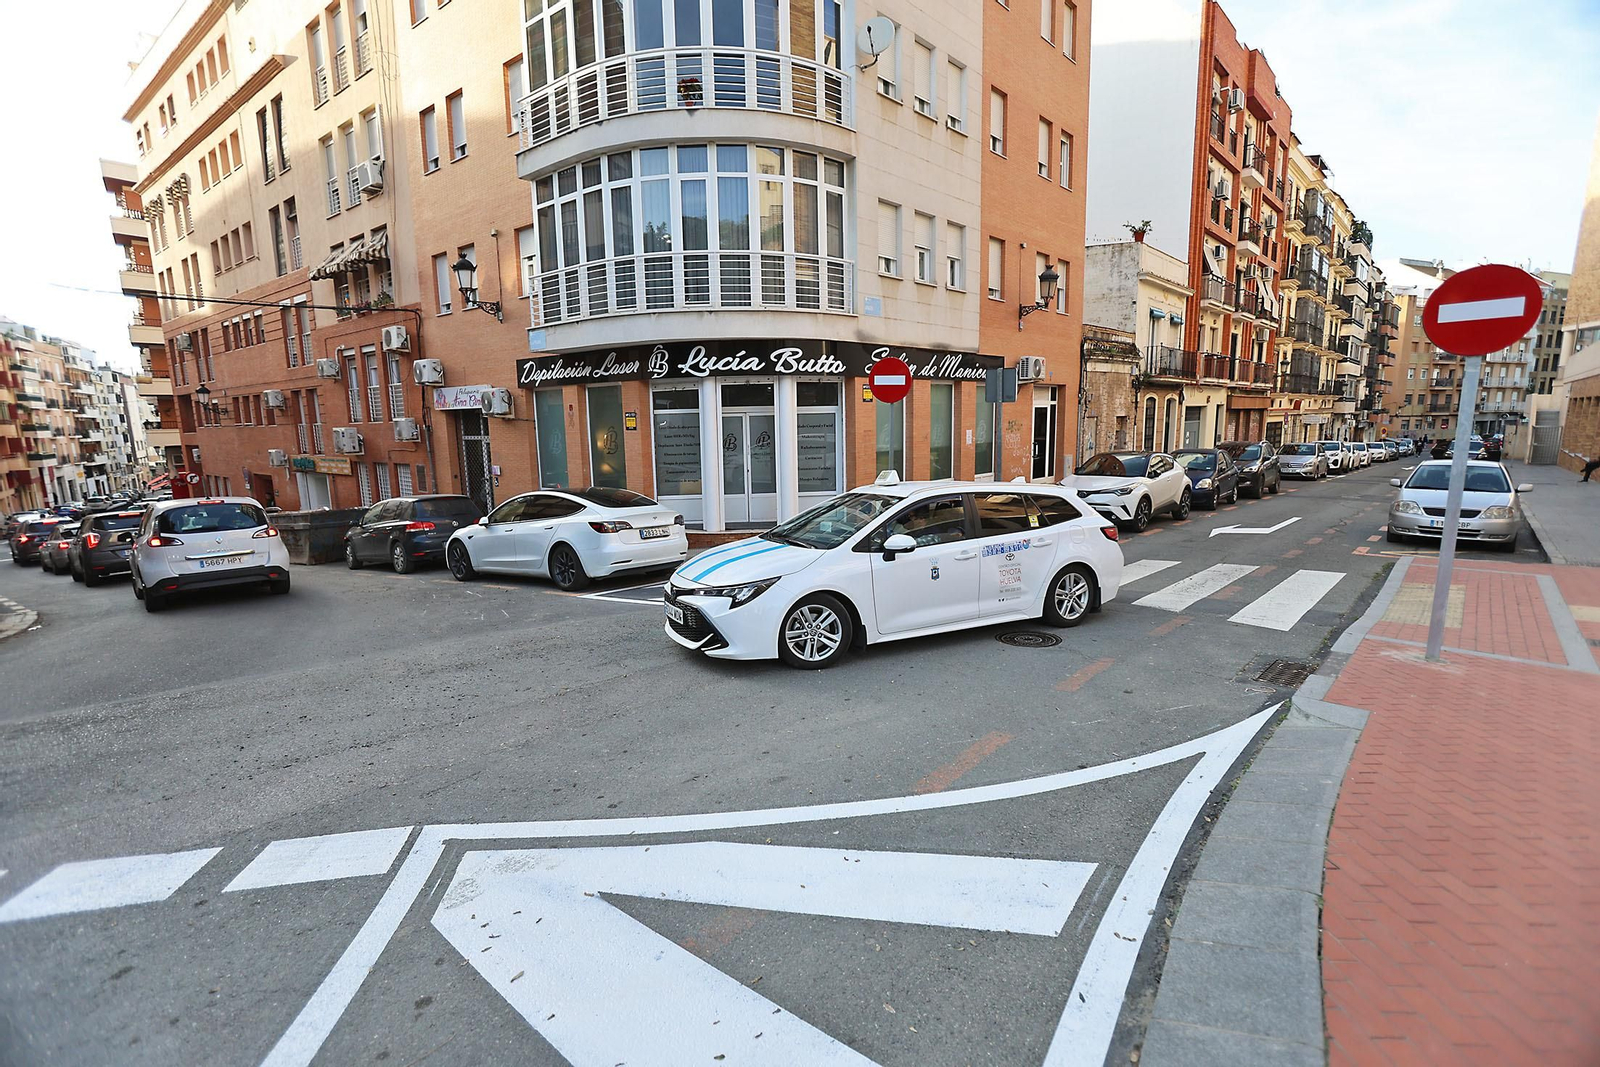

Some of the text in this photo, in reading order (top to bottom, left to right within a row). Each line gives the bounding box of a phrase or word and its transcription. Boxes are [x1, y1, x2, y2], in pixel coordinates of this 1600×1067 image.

[520, 351, 640, 387] Depilación Laser
[677, 345, 847, 377] Lucía Butto
[918, 354, 938, 377] de
[938, 353, 988, 379] Manicu
[205, 558, 225, 567] 5667
[999, 567, 1021, 577] TOYOTA
[999, 576, 1021, 586] HUELVA
